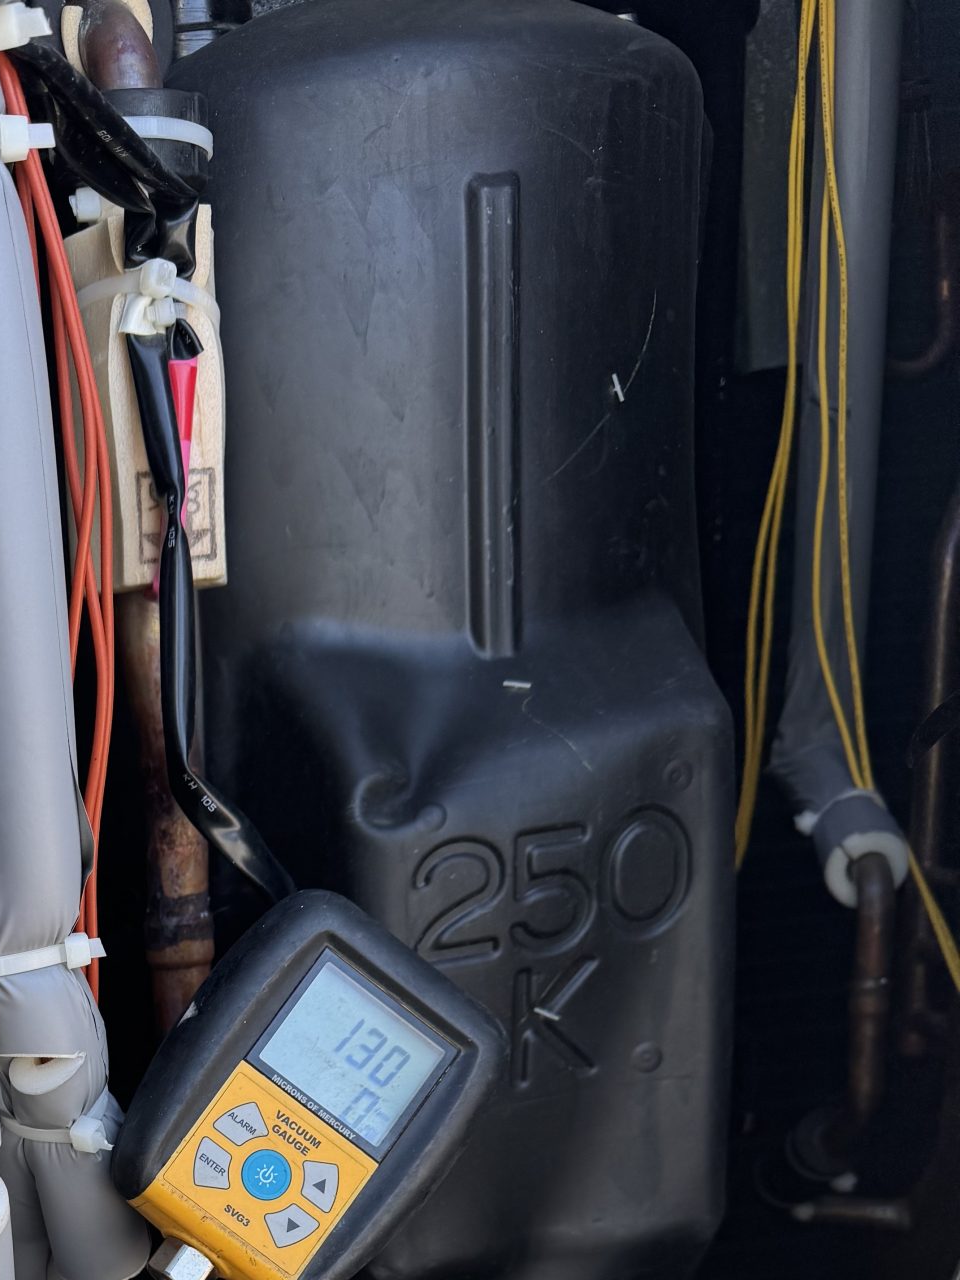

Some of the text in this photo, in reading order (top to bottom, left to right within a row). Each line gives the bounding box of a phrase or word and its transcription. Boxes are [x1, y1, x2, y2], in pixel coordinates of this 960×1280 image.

[201, 795, 217, 813] 105
[411, 803, 694, 968] 250
[510, 955, 600, 1089] K
[334, 1018, 411, 1088] 130
[228, 1111, 257, 1136] ALARM
[271, 1074, 308, 1103] MICRONS
[307, 1101, 320, 1114] OF
[318, 1109, 357, 1141] MERCURY
[271, 1124, 311, 1157] GAUGE
[275, 1110, 322, 1149] VACUUM
[198, 1152, 227, 1177] ENTER
[224, 1204, 251, 1227] SVG3
